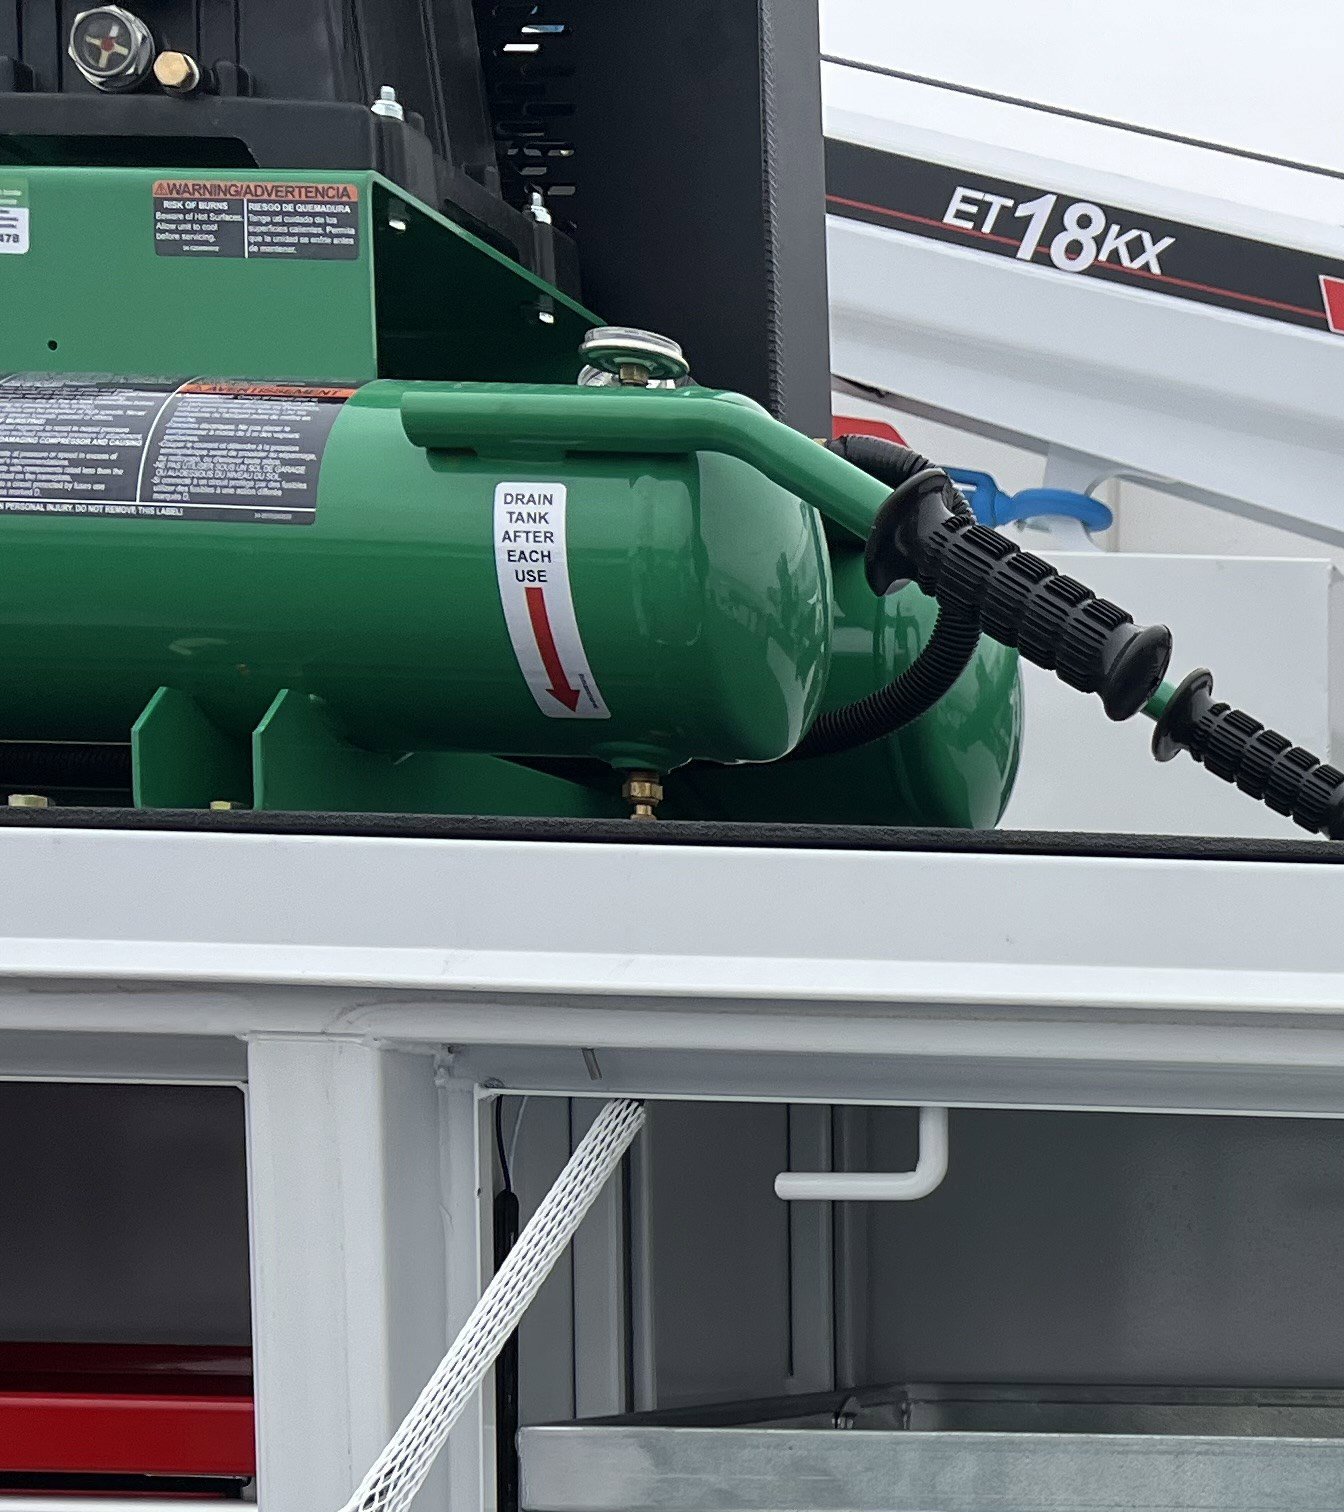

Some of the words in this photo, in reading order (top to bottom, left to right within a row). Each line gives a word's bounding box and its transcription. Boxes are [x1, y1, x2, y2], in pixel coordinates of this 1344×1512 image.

[167, 182, 351, 200] WARNING/ADVERTENCIA
[185, 201, 197, 209] OF
[198, 201, 229, 210] BURNS
[282, 203, 295, 212] DE
[503, 492, 554, 506] DRAIN
[506, 511, 549, 525] TANK
[501, 530, 554, 544] AFTER
[507, 549, 552, 563] EACH
[514, 569, 548, 583] USE
